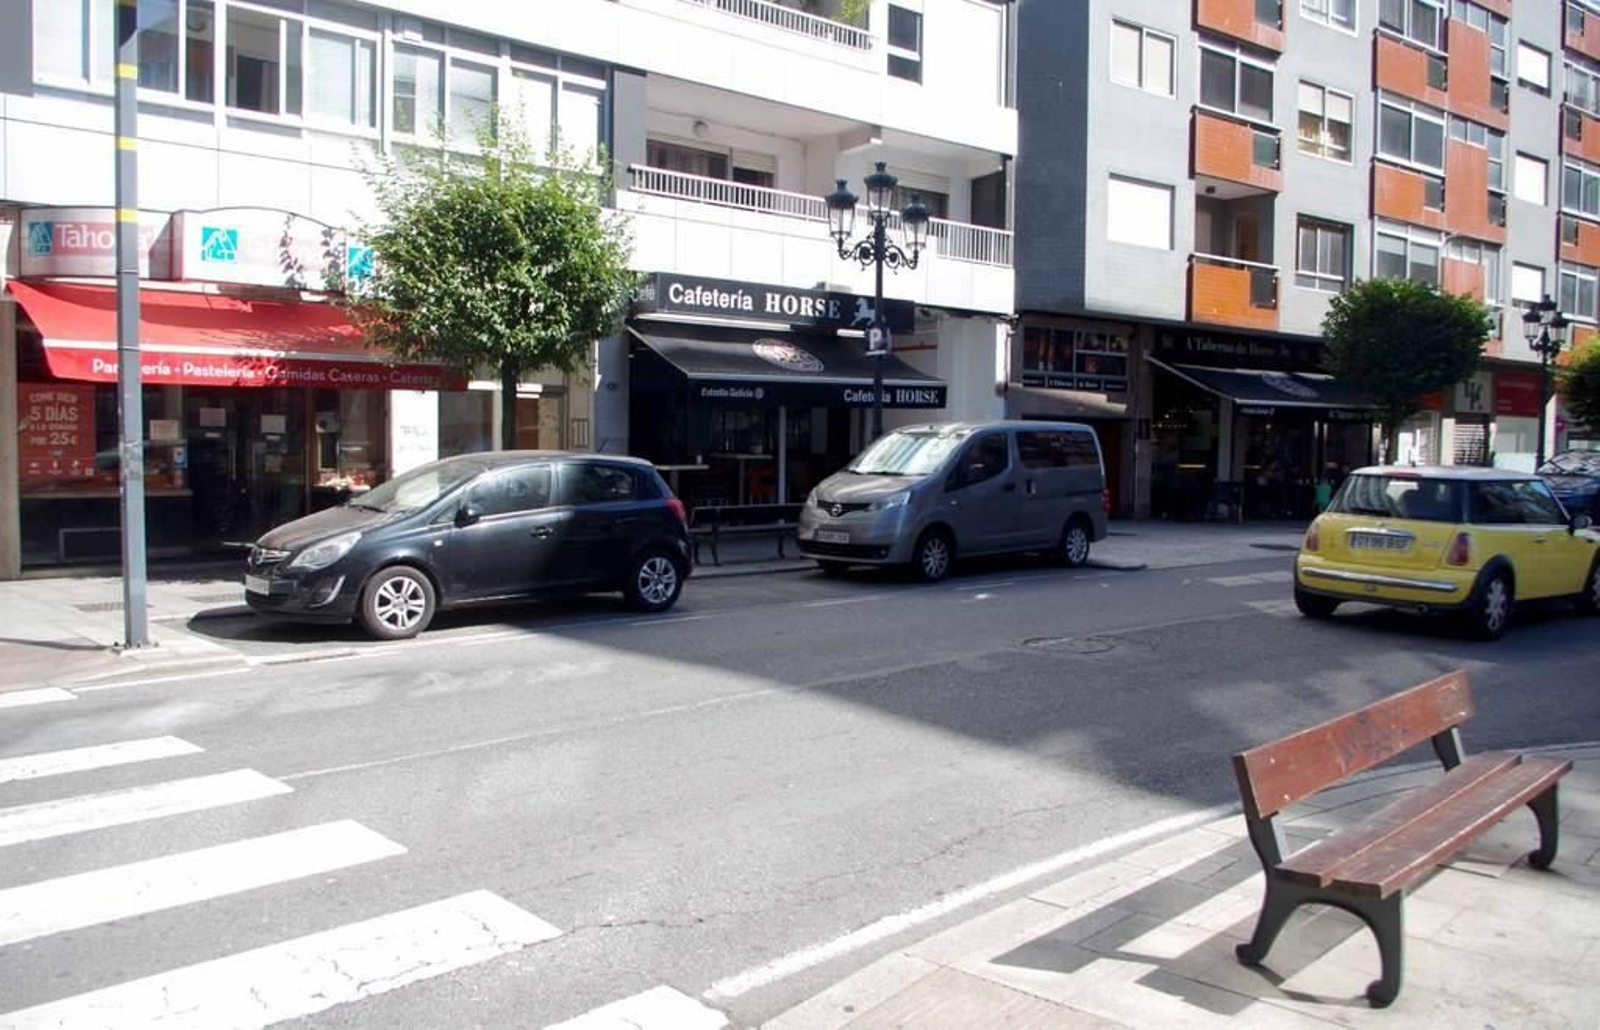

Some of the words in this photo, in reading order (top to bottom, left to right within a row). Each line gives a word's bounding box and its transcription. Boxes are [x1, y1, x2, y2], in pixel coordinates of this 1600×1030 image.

[668, 283, 754, 312] Cafetería
[765, 292, 842, 320] HORSE
[183, 361, 255, 379] Pastelería
[328, 368, 380, 384] Caseras
[896, 388, 939, 403] HORSE
[30, 405, 41, 421] 5
[45, 402, 78, 422] DÍAS
